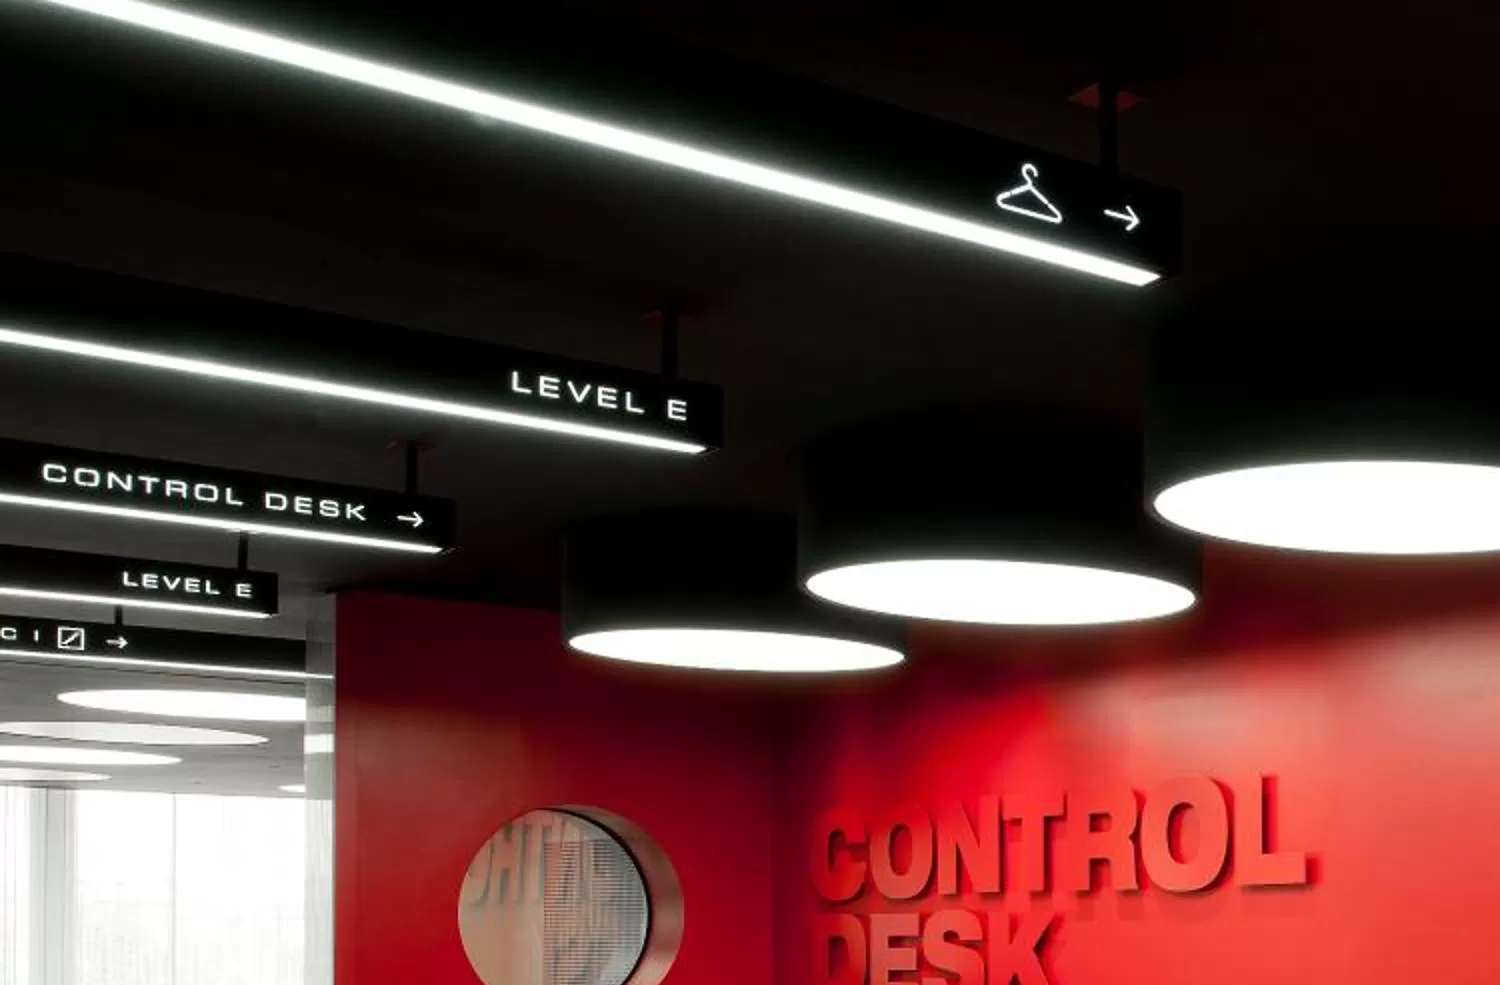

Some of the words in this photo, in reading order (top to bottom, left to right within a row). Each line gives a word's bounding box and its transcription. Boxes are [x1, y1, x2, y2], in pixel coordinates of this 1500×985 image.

[511, 370, 645, 415] LEVEL
[667, 398, 688, 422] E
[42, 463, 244, 507] CONTROL
[264, 491, 367, 522] DESK
[121, 570, 221, 596] LEVEL
[235, 582, 253, 598] E
[811, 773, 1311, 903] CONTROL
